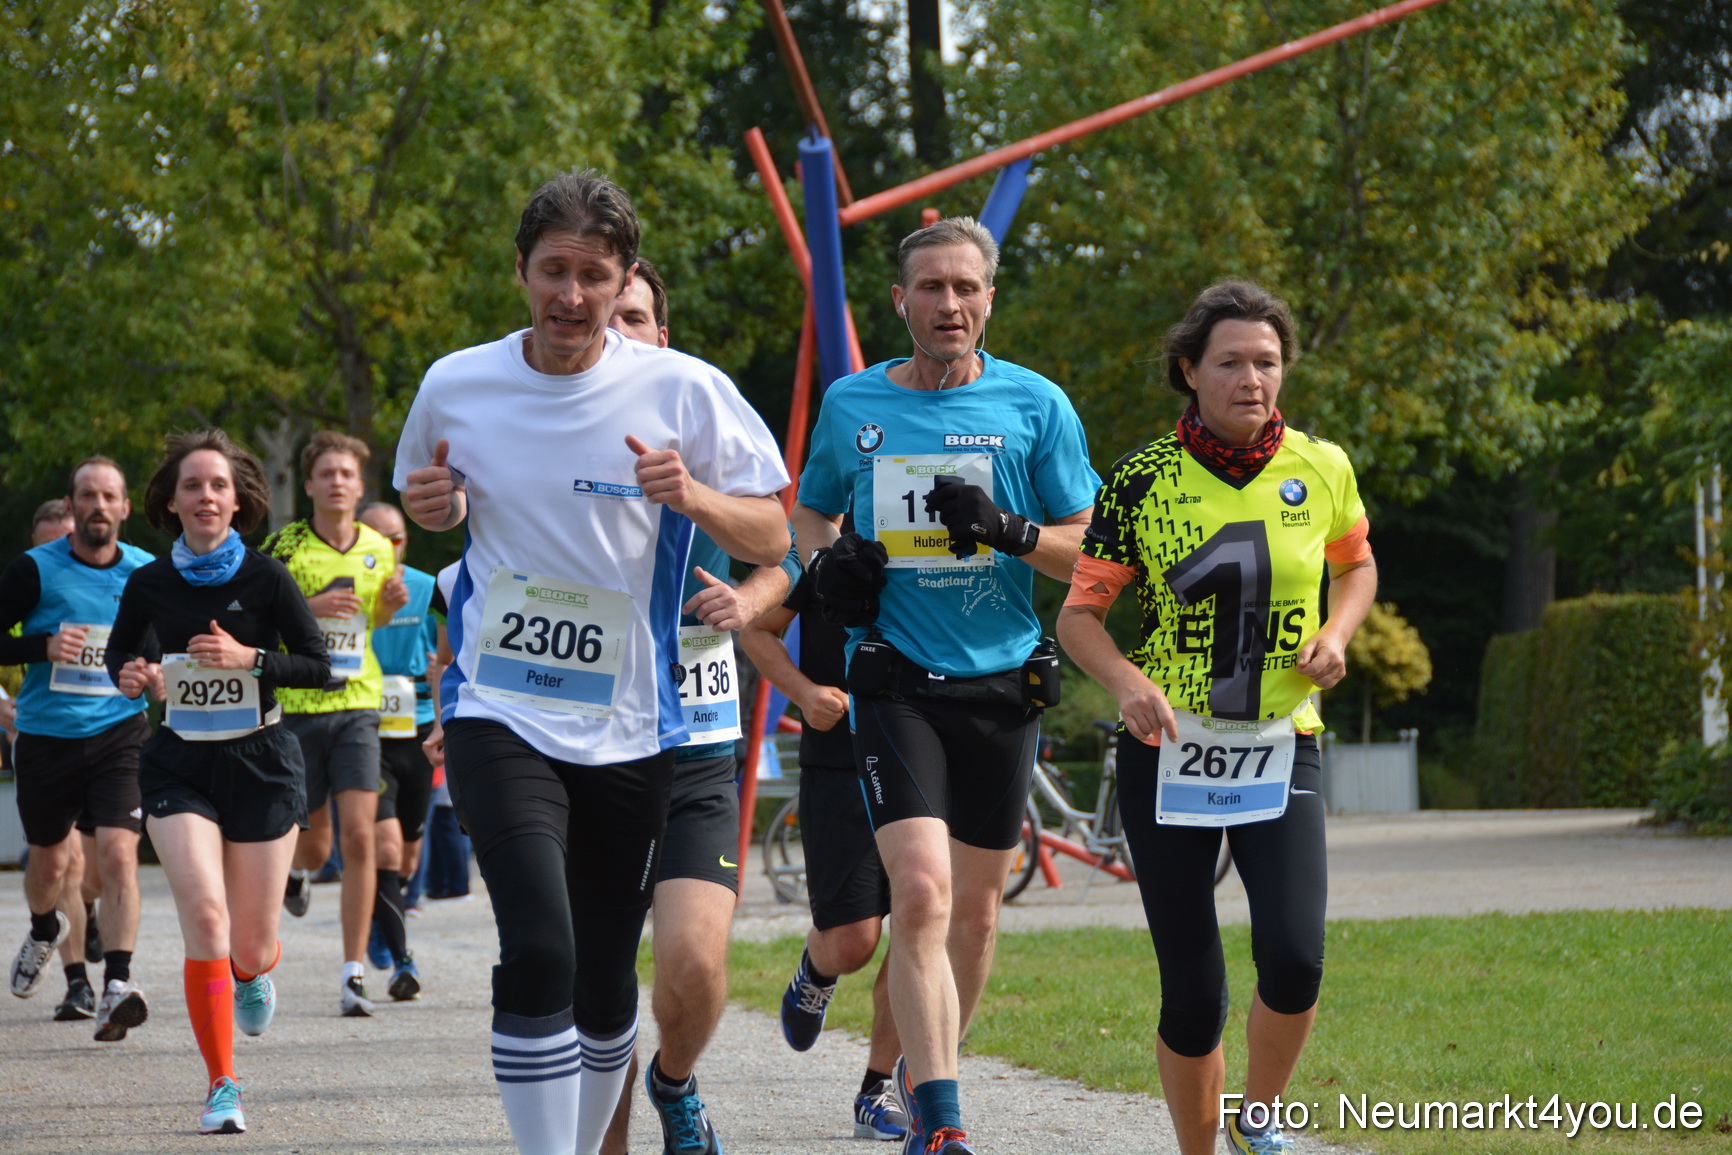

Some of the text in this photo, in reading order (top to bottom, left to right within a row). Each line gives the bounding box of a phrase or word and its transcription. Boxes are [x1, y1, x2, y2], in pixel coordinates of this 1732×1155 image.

[944, 434, 1006, 449] BOCK
[916, 465, 957, 475] BOCK
[1280, 509, 1310, 522] Partl
[918, 575, 975, 588] Stadtlauf
[539, 588, 588, 605] BOCK
[1283, 599, 1298, 607] BMW
[322, 632, 357, 650] 674
[499, 612, 603, 664] 2306
[1240, 653, 1298, 672] WEITER
[526, 669, 564, 689] Peter
[678, 660, 730, 698] 2136
[177, 678, 244, 706] 2929
[693, 711, 718, 723] Andre
[1215, 720, 1259, 731] BOCK
[1179, 742, 1274, 779] 2677
[870, 770, 884, 804] Löffler
[1207, 792, 1241, 806] Karin
